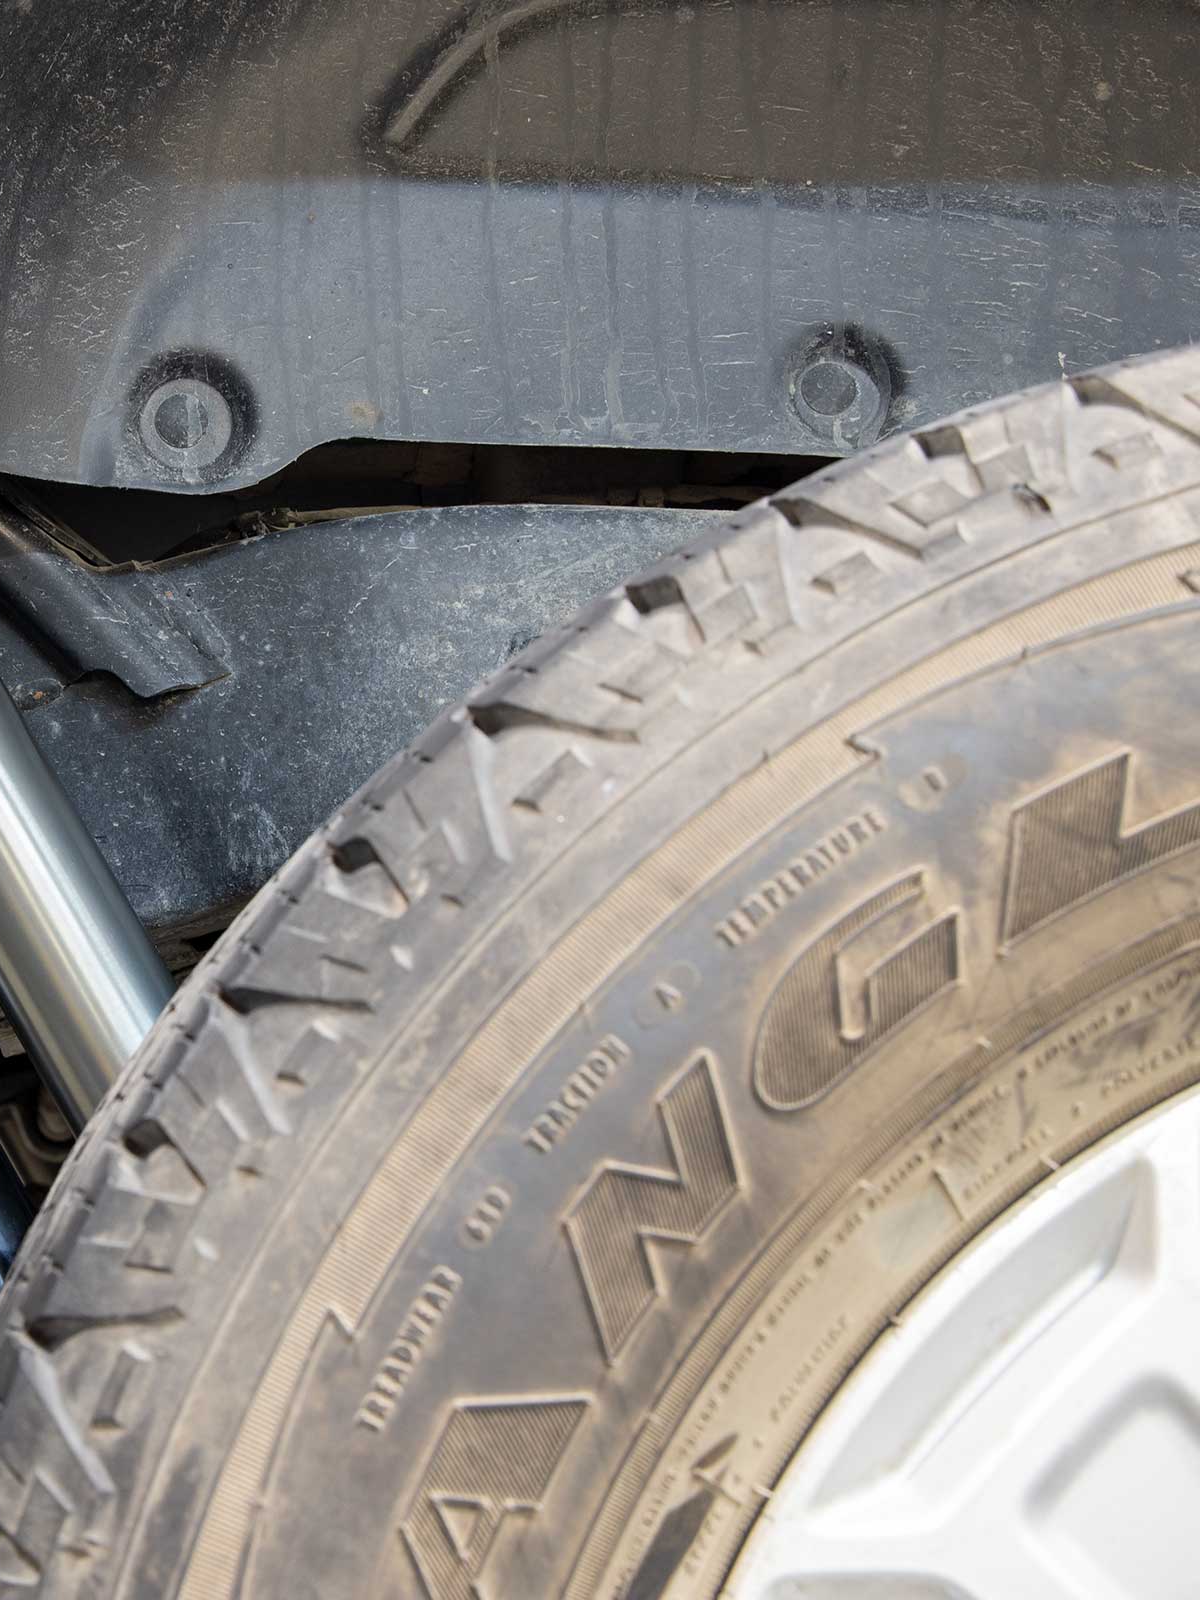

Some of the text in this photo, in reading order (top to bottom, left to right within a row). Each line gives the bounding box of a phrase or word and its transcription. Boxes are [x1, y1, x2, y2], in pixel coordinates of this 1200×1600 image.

[355, 1264, 463, 1434] TREADWEAR
[521, 1034, 630, 1154] TRACTION
[653, 982, 683, 1011] A
[715, 809, 888, 947] TEMPERATURE
